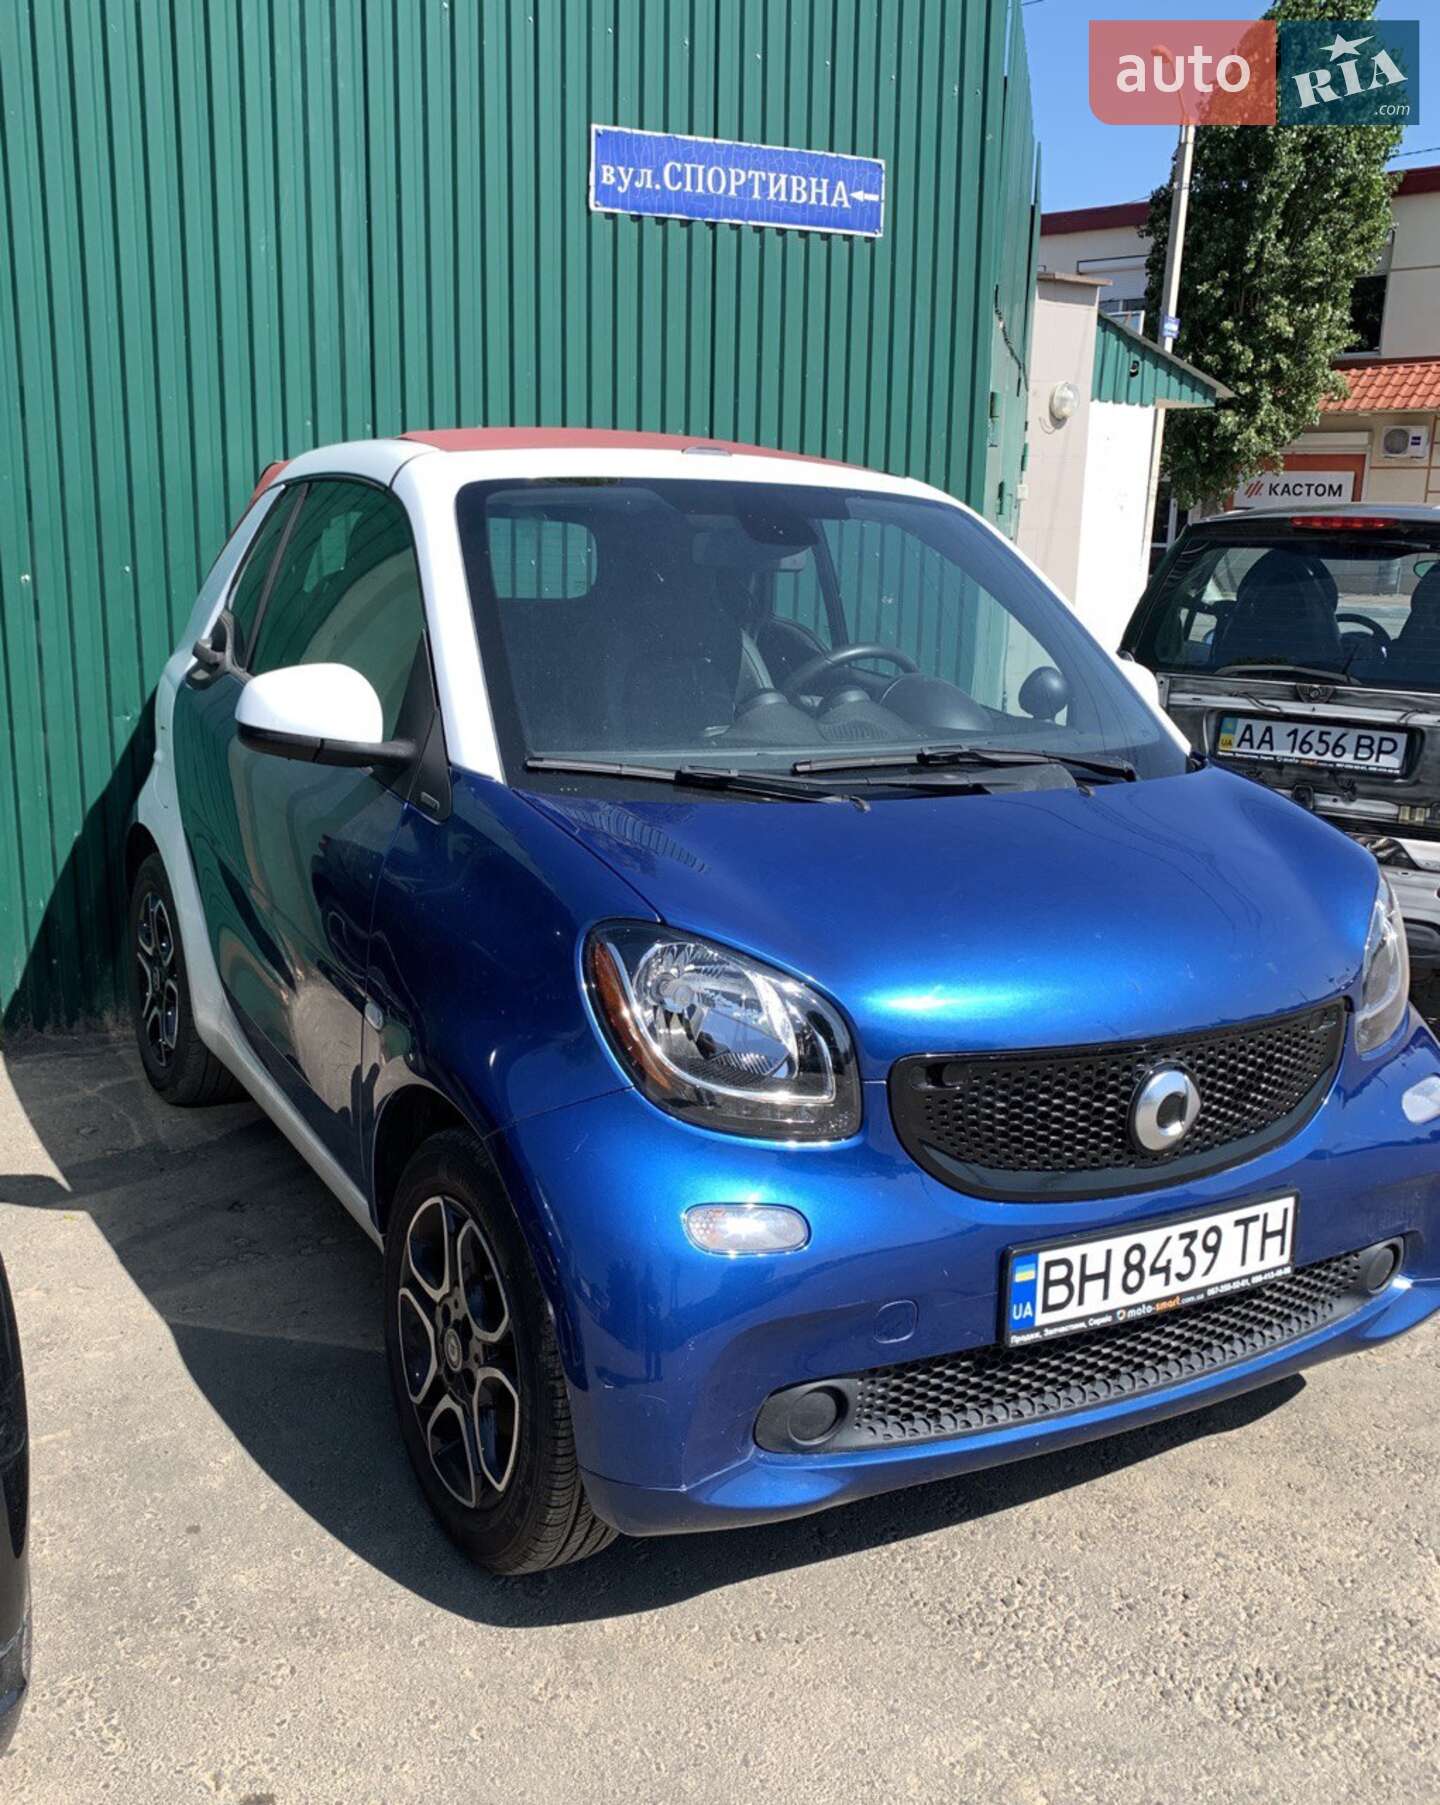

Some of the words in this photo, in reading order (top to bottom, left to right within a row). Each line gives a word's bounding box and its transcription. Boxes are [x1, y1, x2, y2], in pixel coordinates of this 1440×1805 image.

[1268, 482, 1343, 498] КАСТОМ
[1237, 723, 1275, 751] AA
[1286, 727, 1349, 758] 1656
[1353, 734, 1399, 763] BP
[1041, 1248, 1113, 1314] BH
[1120, 1224, 1223, 1296] 8439
[1233, 1207, 1290, 1268] TH
[1012, 1301, 1033, 1321] UA
